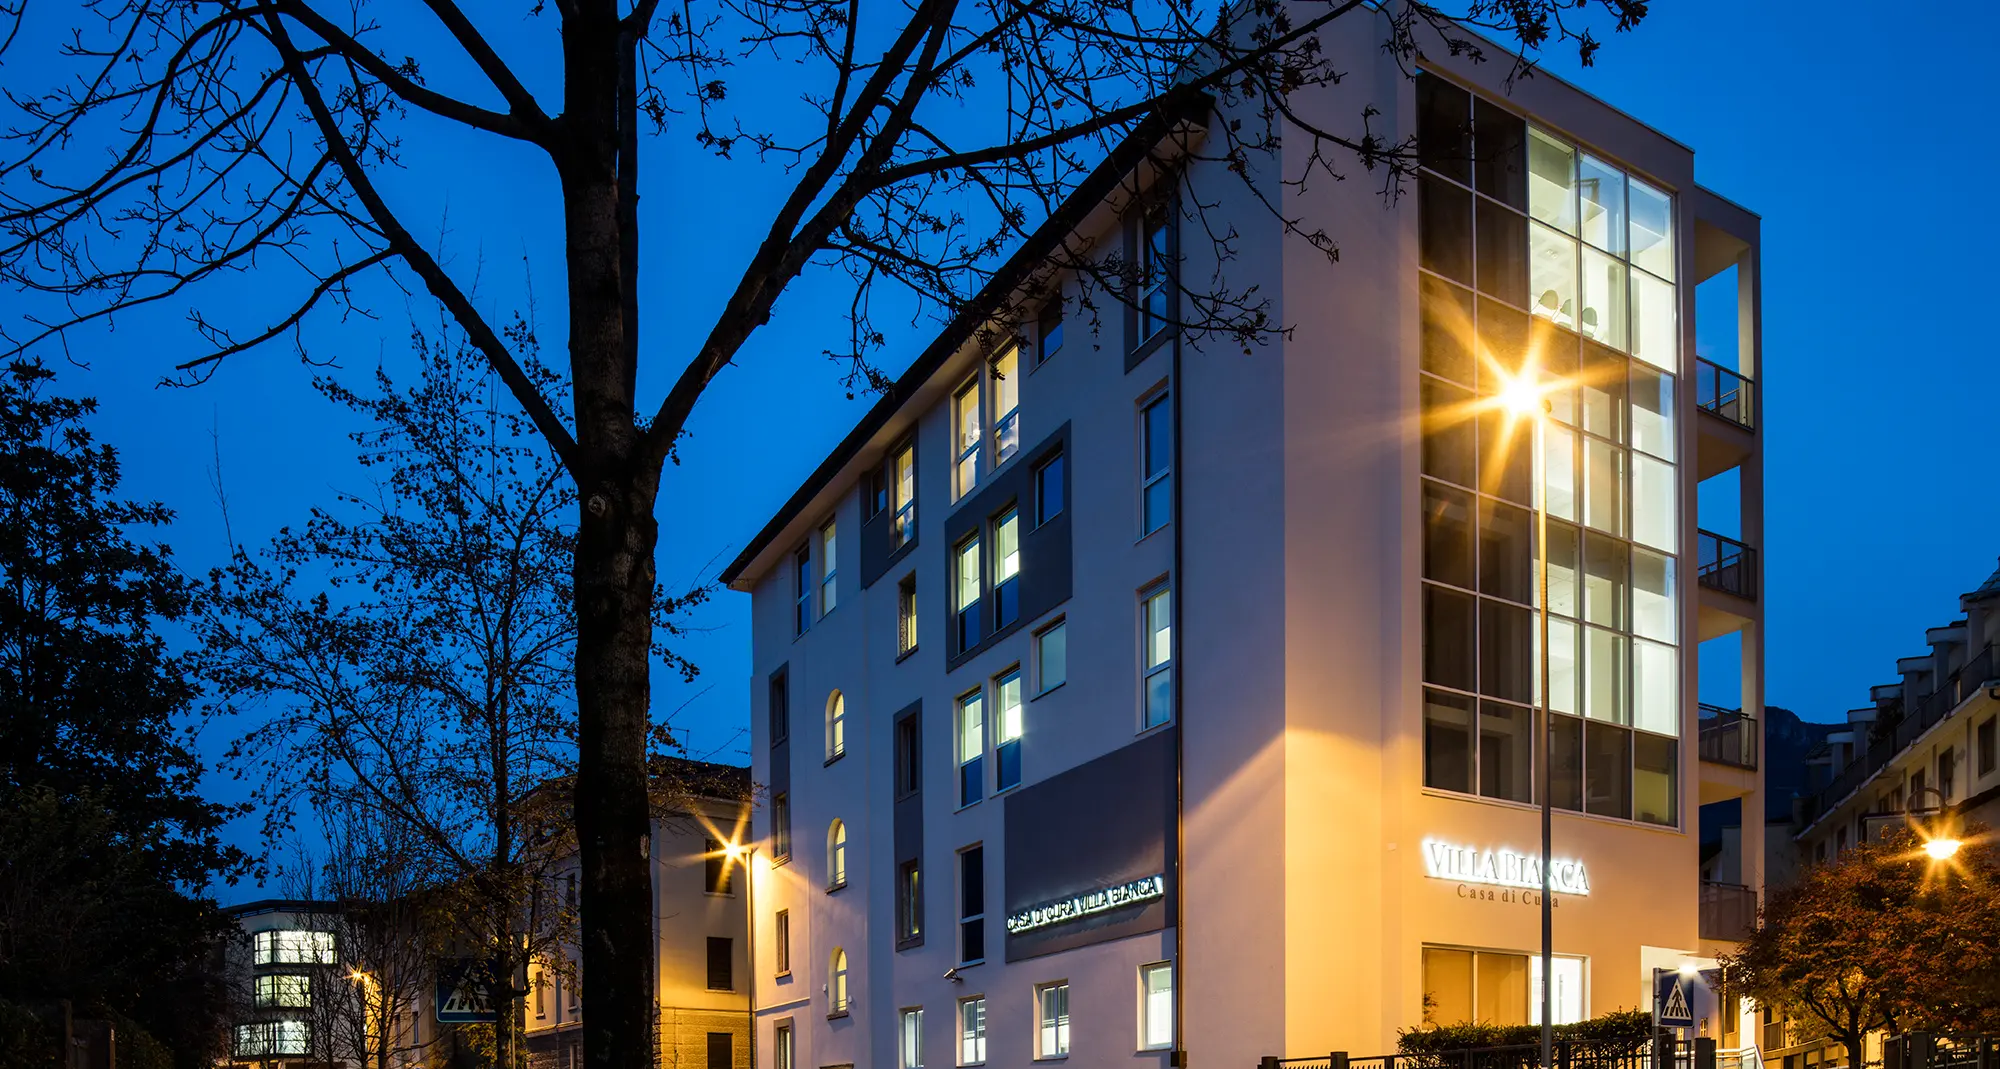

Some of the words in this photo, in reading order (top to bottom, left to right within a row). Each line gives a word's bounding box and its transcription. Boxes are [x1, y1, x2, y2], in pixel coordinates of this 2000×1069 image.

[1007, 911, 1033, 930] CASA
[1047, 900, 1075, 920] CURA
[1079, 889, 1109, 911] VILLA
[1112, 876, 1157, 904] BIANCA
[1457, 884, 1494, 901] Casa
[1501, 889, 1516, 904] di
[1522, 890, 1559, 908] Cua
